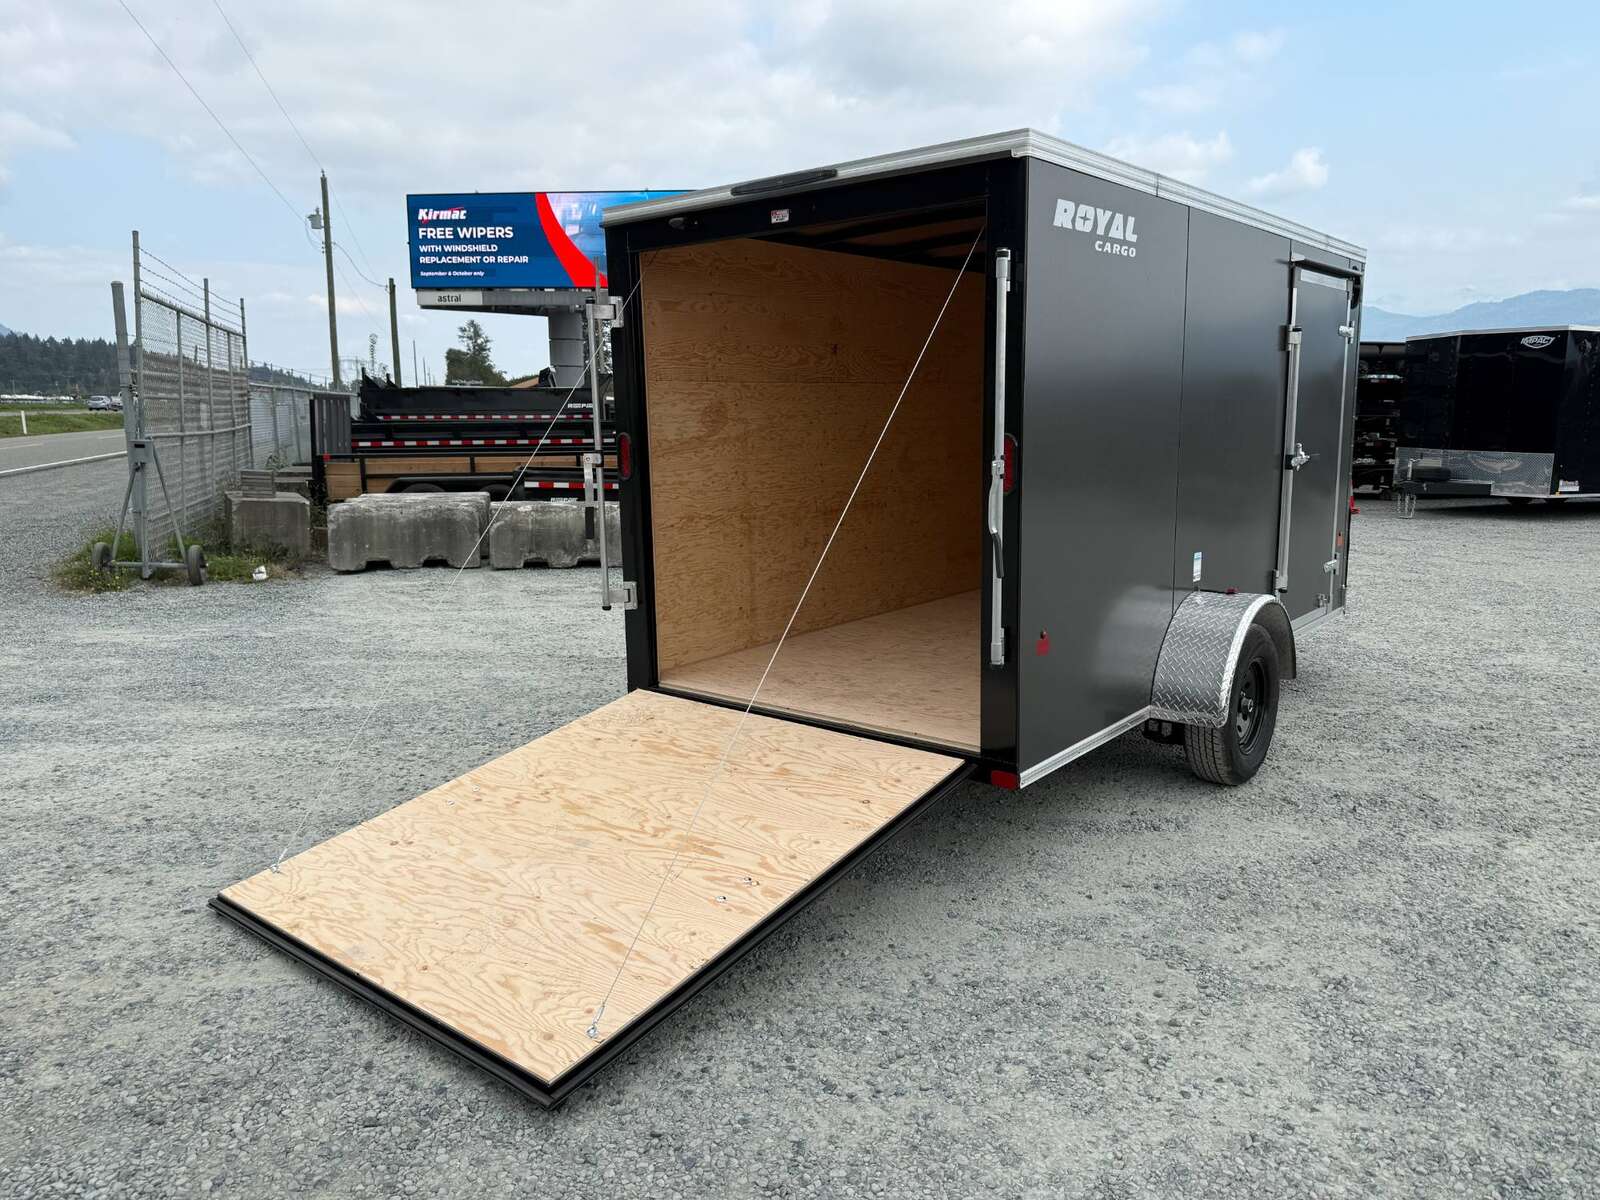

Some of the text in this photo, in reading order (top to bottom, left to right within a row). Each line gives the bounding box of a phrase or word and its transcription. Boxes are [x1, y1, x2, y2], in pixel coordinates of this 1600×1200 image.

[417, 208, 467, 221] Kirmac
[1053, 198, 1138, 243] ROYAL
[418, 226, 514, 239] FREE WIPERS
[419, 244, 498, 253] WITH WINDSHIELD
[1094, 240, 1137, 258] CARGO
[419, 255, 529, 264] REPLACEMENT OR REPAIR
[437, 293, 462, 303] astral
